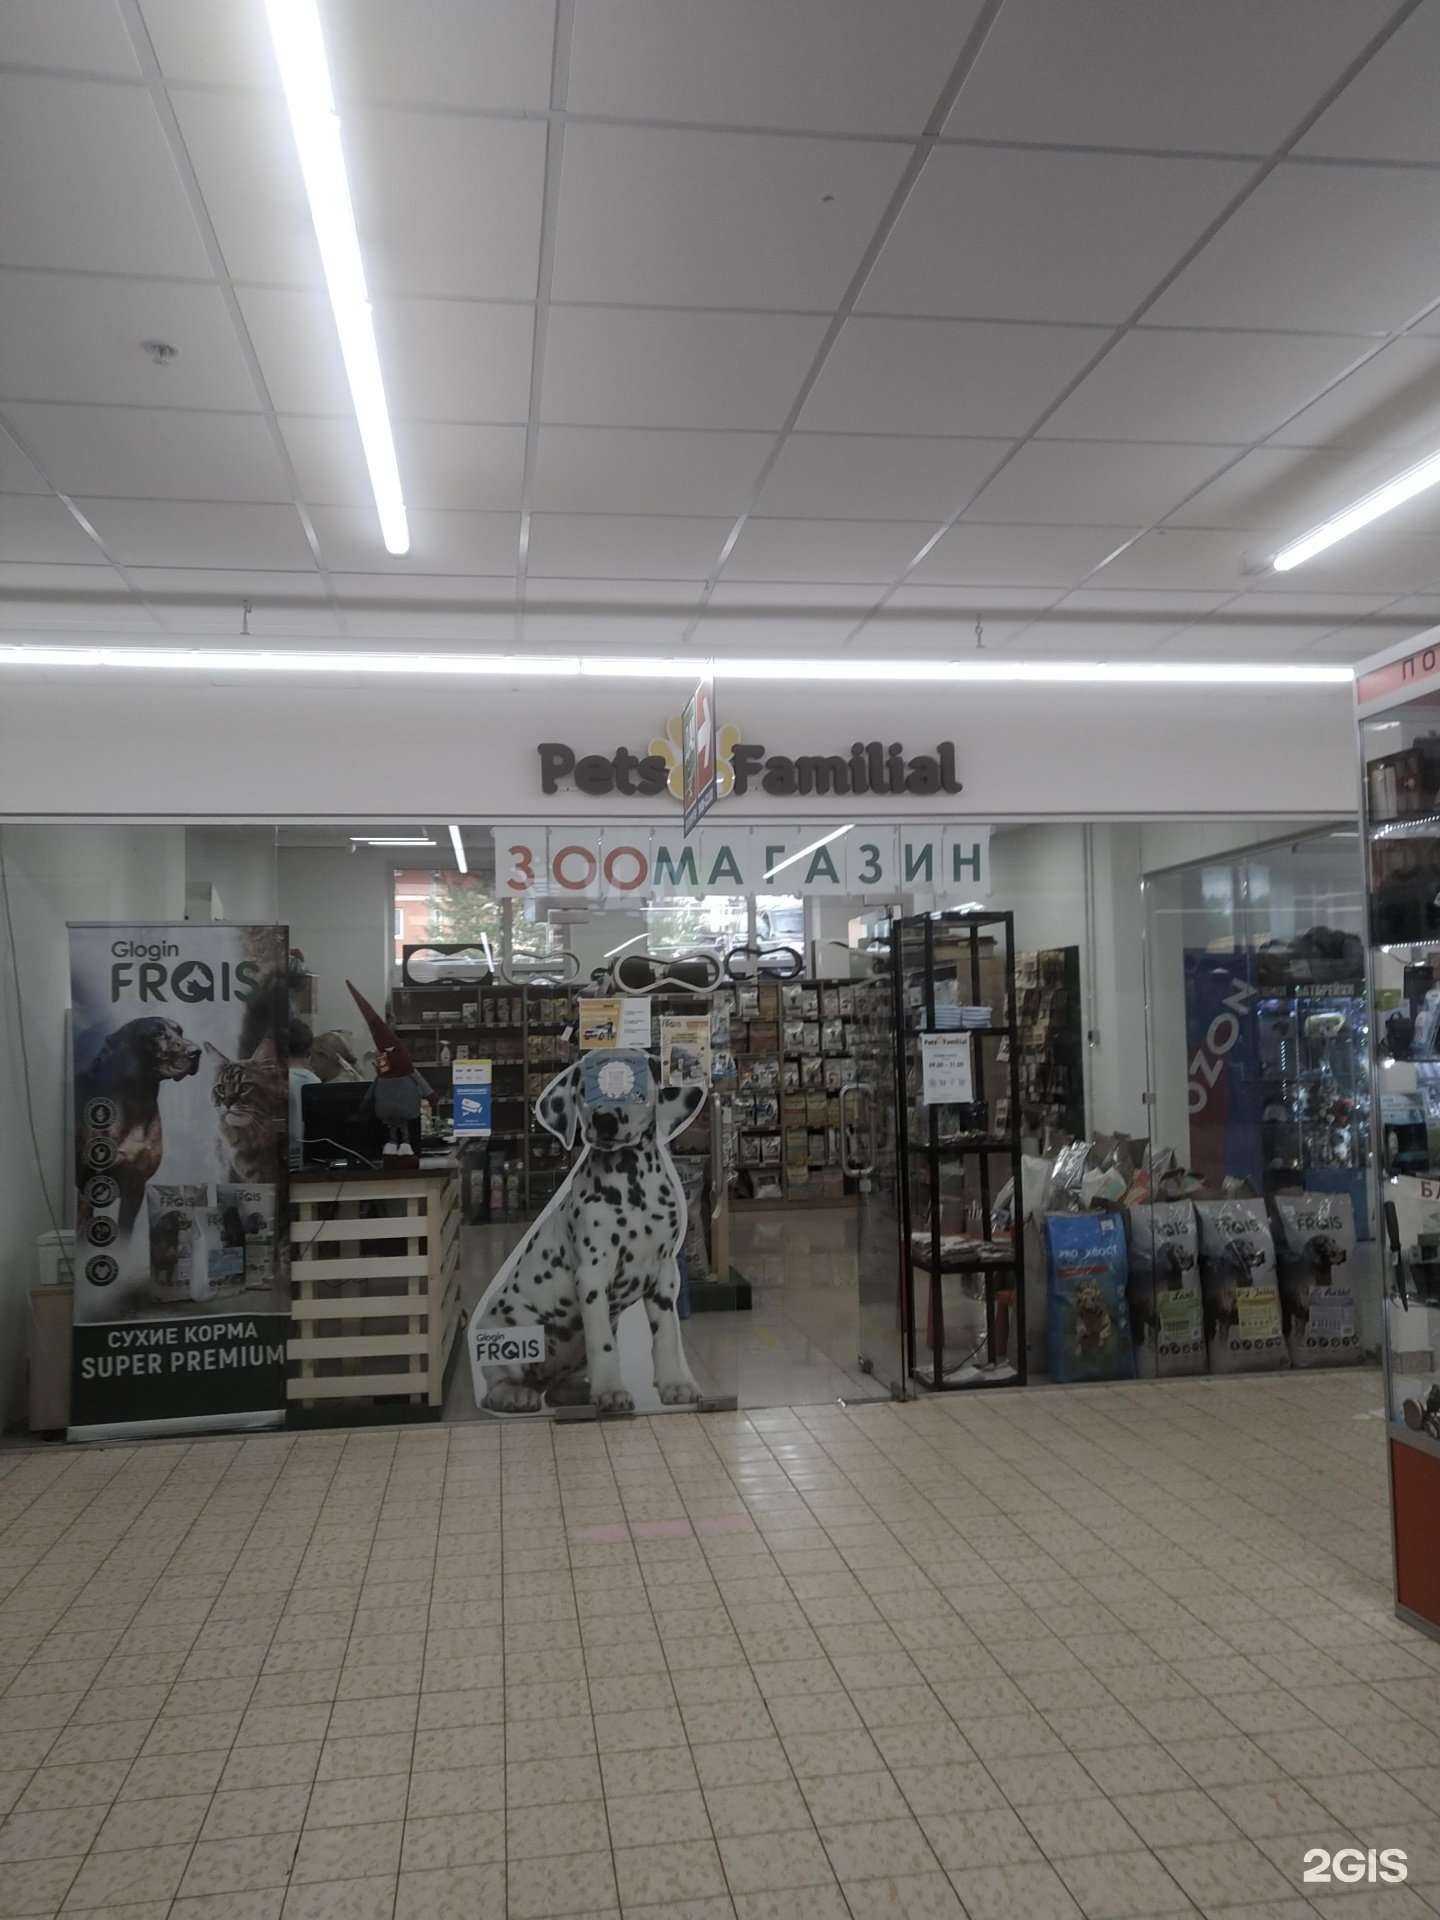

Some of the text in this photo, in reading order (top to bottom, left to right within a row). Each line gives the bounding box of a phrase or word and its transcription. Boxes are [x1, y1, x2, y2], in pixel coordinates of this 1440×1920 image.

[537, 742, 670, 796] Pets
[730, 741, 963, 796] Familial
[507, 842, 983, 891] ЗООМАГАЗИН
[111, 940, 179, 961] Glogin
[108, 1322, 258, 1348] СУХИЕ КОРМА
[81, 1344, 285, 1379] SUPER PREMIUM
